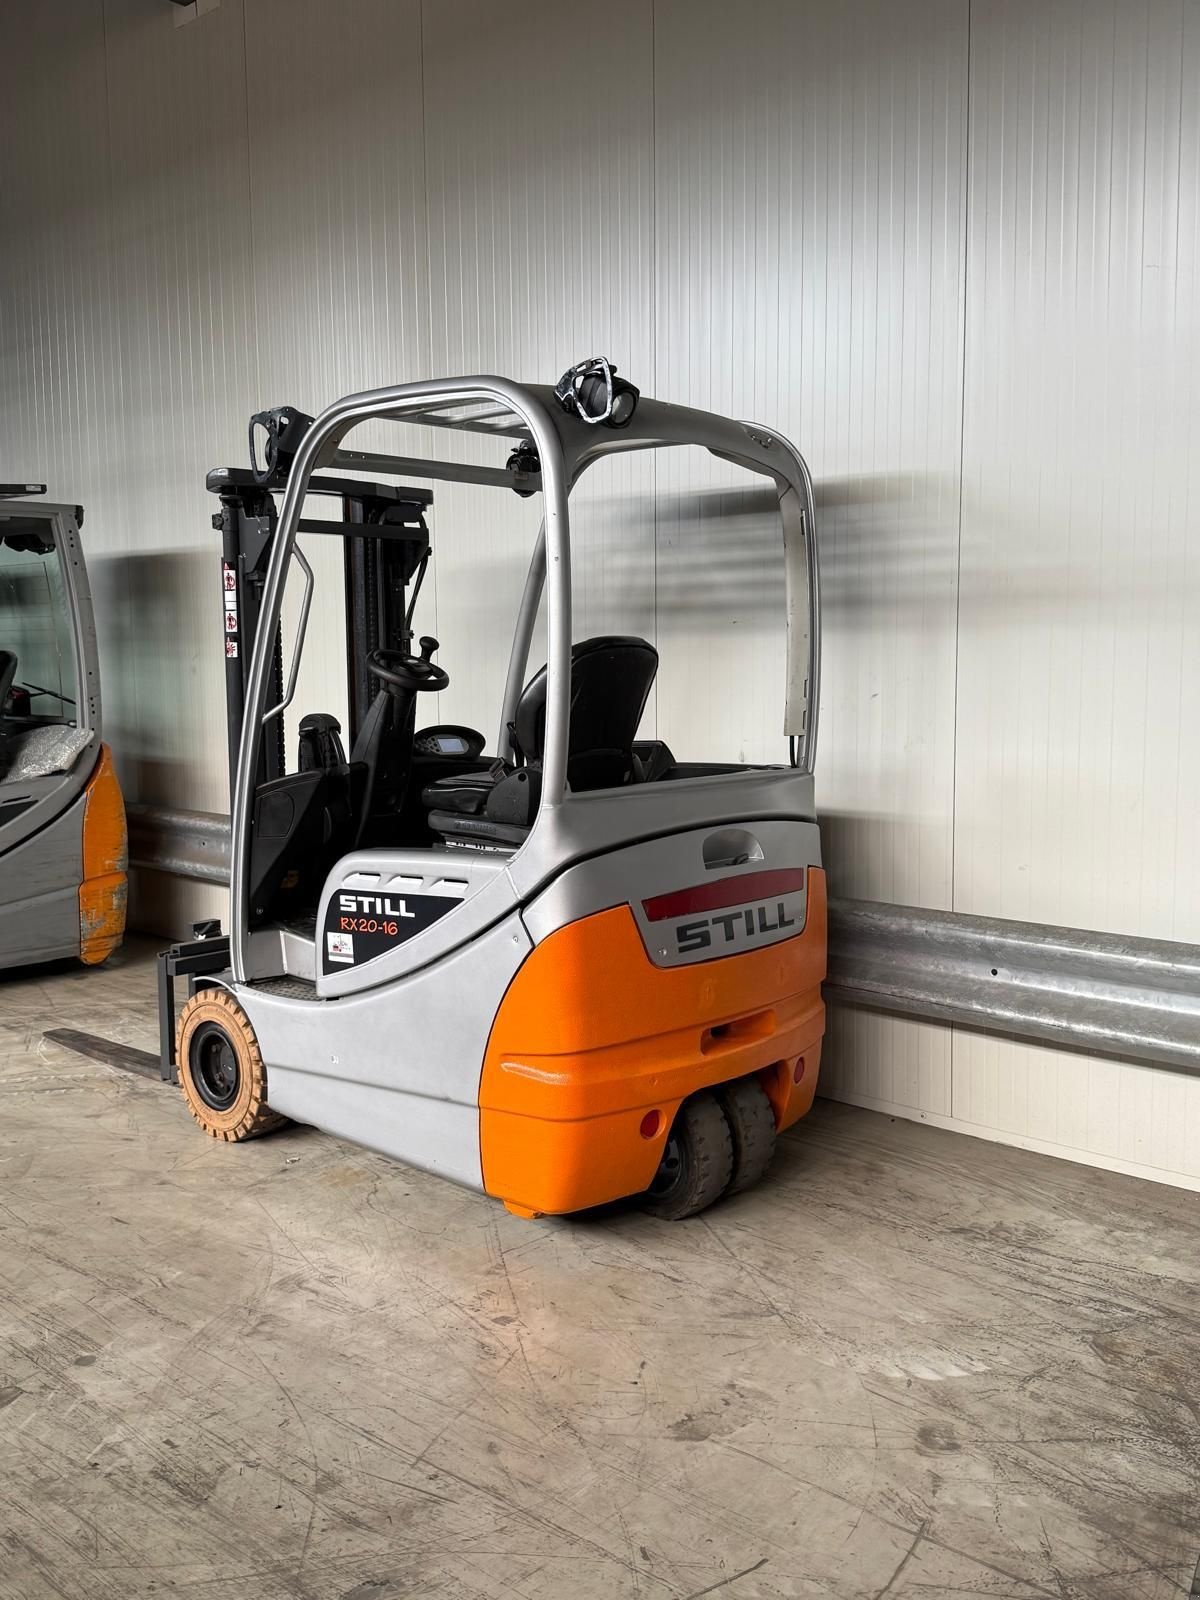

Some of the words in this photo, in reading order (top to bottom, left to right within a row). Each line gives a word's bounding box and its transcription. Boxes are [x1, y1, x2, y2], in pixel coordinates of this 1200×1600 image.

[339, 895, 415, 918] STILL
[340, 917, 398, 936] RX20-16
[676, 903, 794, 953] STILL
